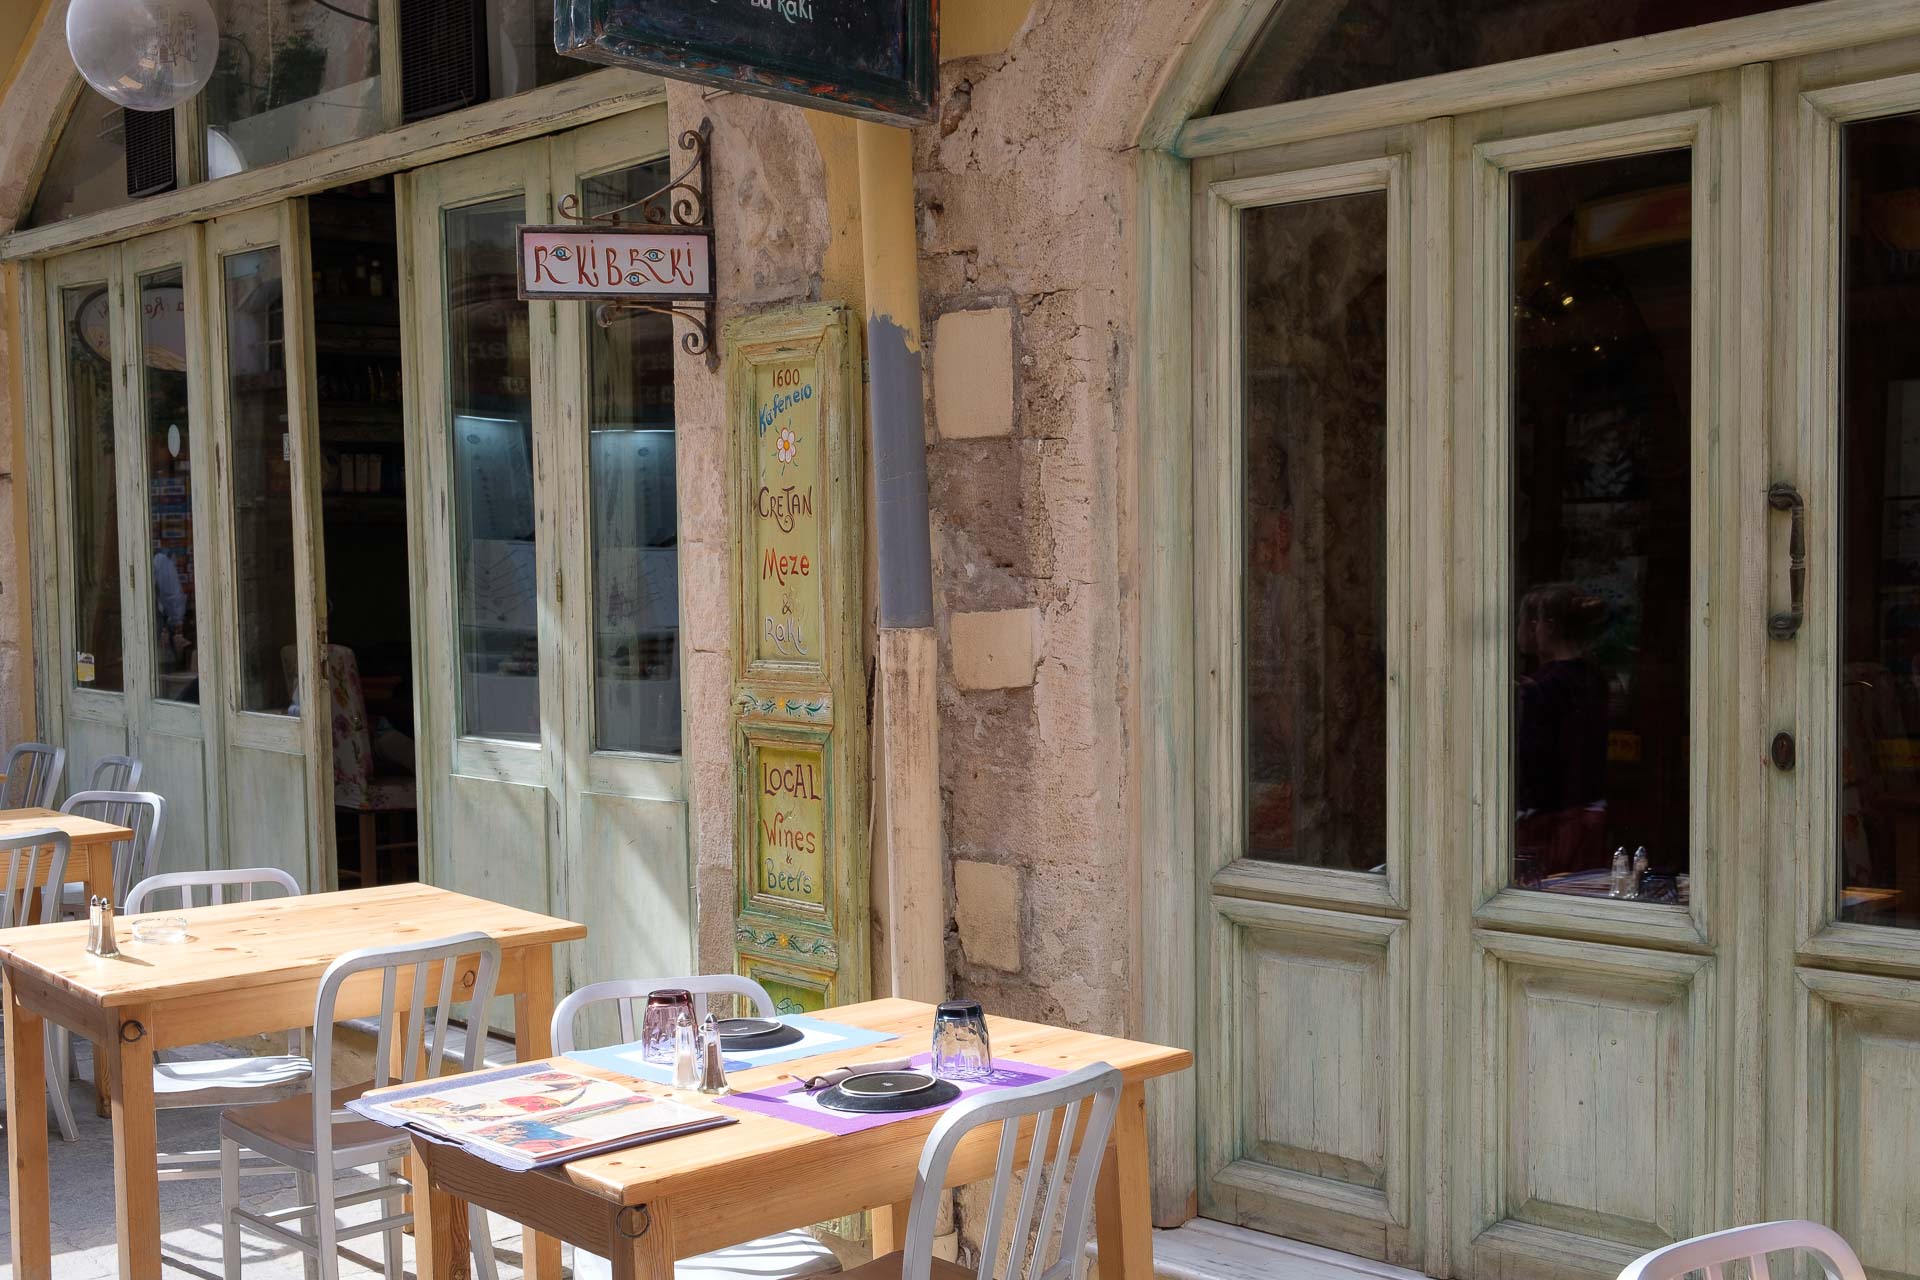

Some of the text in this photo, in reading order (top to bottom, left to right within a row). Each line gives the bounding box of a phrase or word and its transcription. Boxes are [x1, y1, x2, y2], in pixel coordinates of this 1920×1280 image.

[772, 368, 800, 388] 1600
[763, 548, 810, 586] Meze
[763, 812, 816, 854] Wines
[764, 857, 812, 894] Beers
